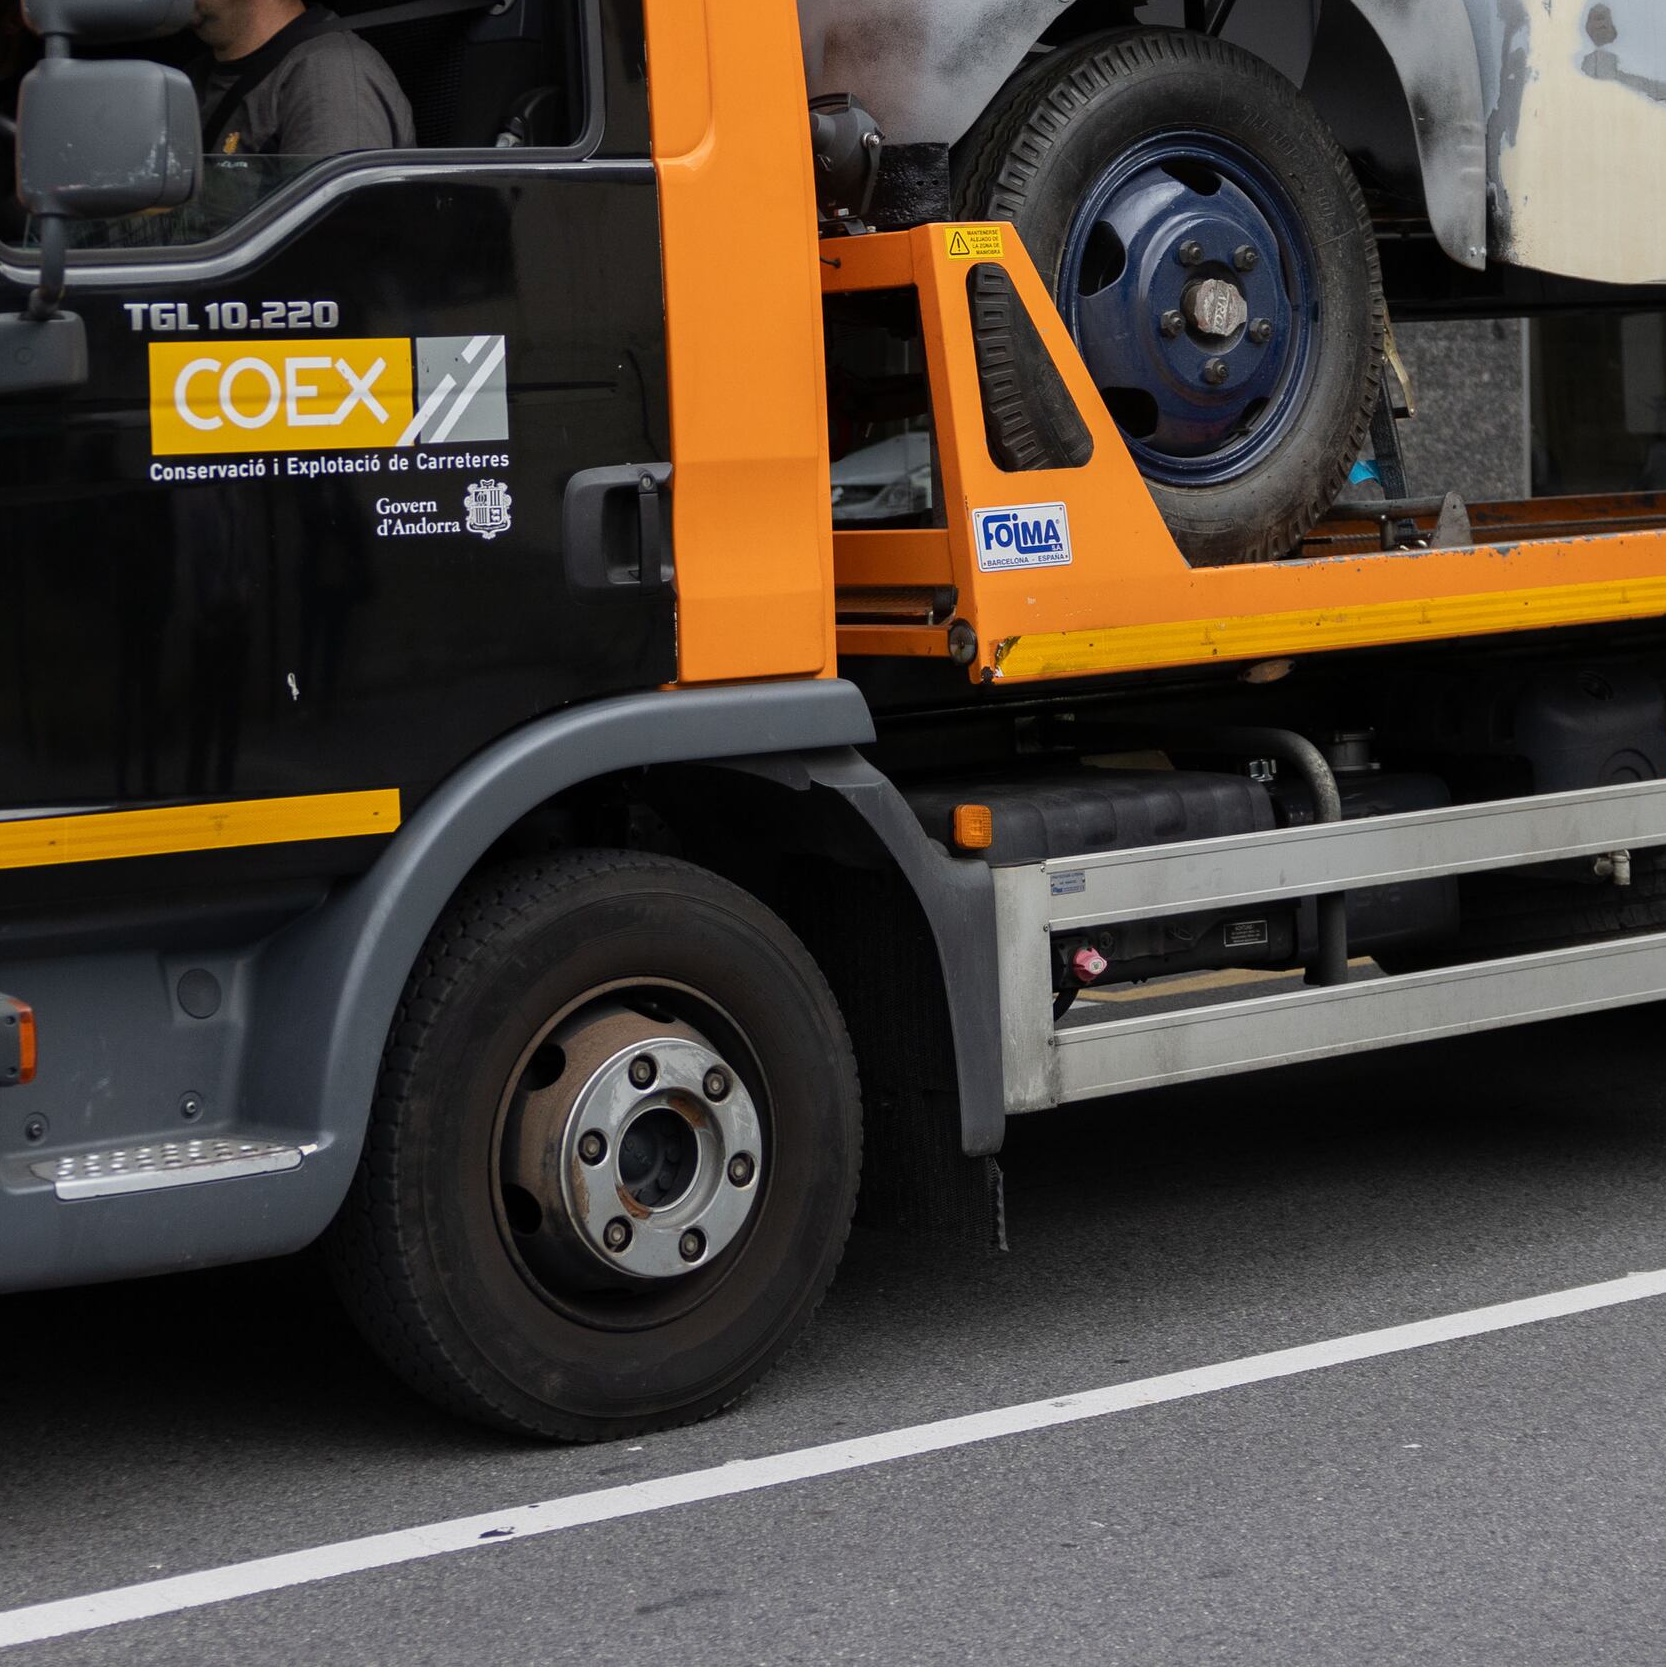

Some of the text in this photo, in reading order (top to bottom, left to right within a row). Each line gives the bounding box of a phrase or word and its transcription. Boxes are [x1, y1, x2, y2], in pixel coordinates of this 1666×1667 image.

[123, 300, 339, 331] TGL 10.220
[174, 355, 390, 431] COEX
[149, 451, 510, 482] Conservació i Explotació de Carreteres
[376, 495, 438, 515] Govern
[376, 516, 461, 537] d'Andorra
[986, 552, 1065, 567] BARCELONA ESPAÑA
